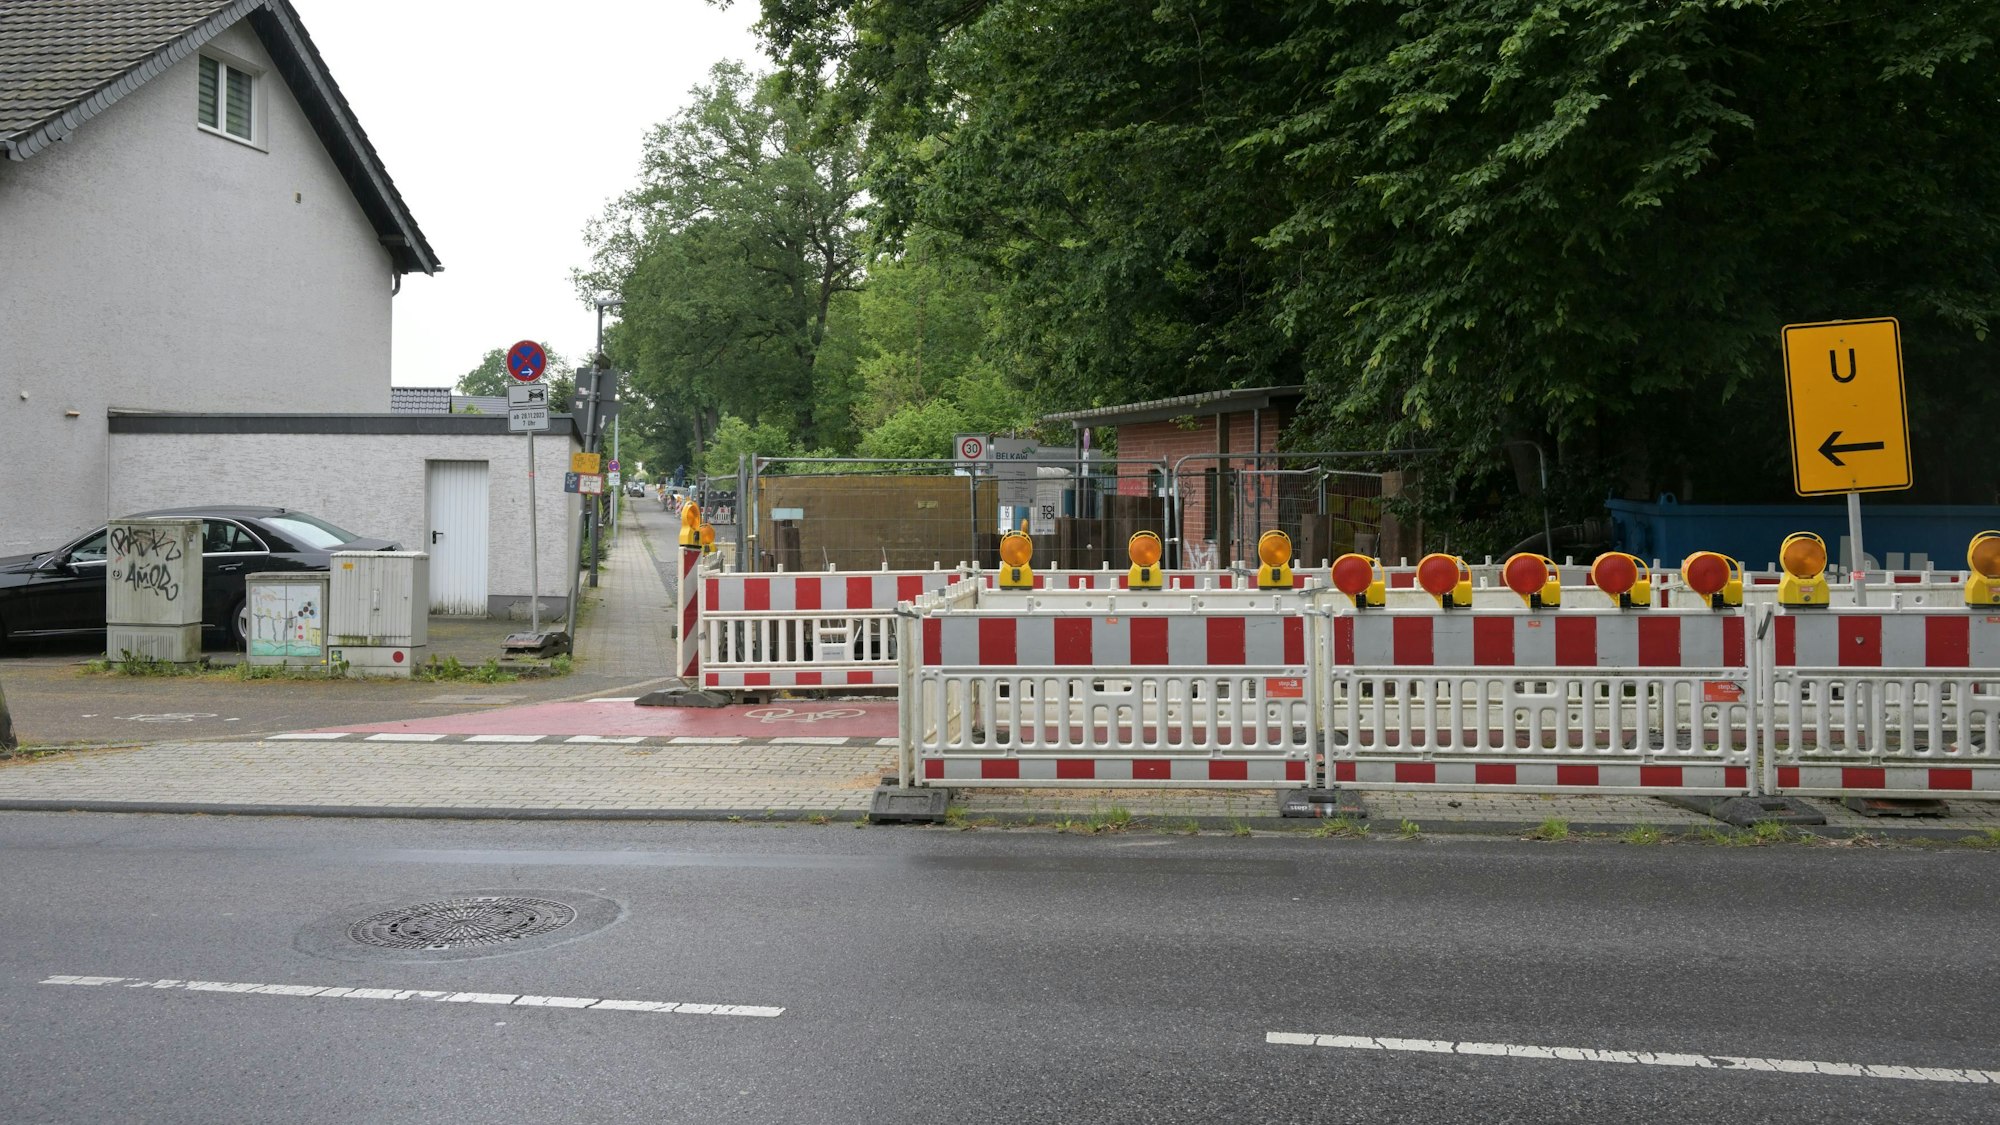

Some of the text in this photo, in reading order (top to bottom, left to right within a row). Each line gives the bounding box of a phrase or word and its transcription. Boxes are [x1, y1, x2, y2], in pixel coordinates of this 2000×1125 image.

[1829, 348, 1857, 383] U
[966, 444, 978, 454] 30
[996, 452, 1028, 460] BELKAW
[1042, 512, 1055, 520] TOI
